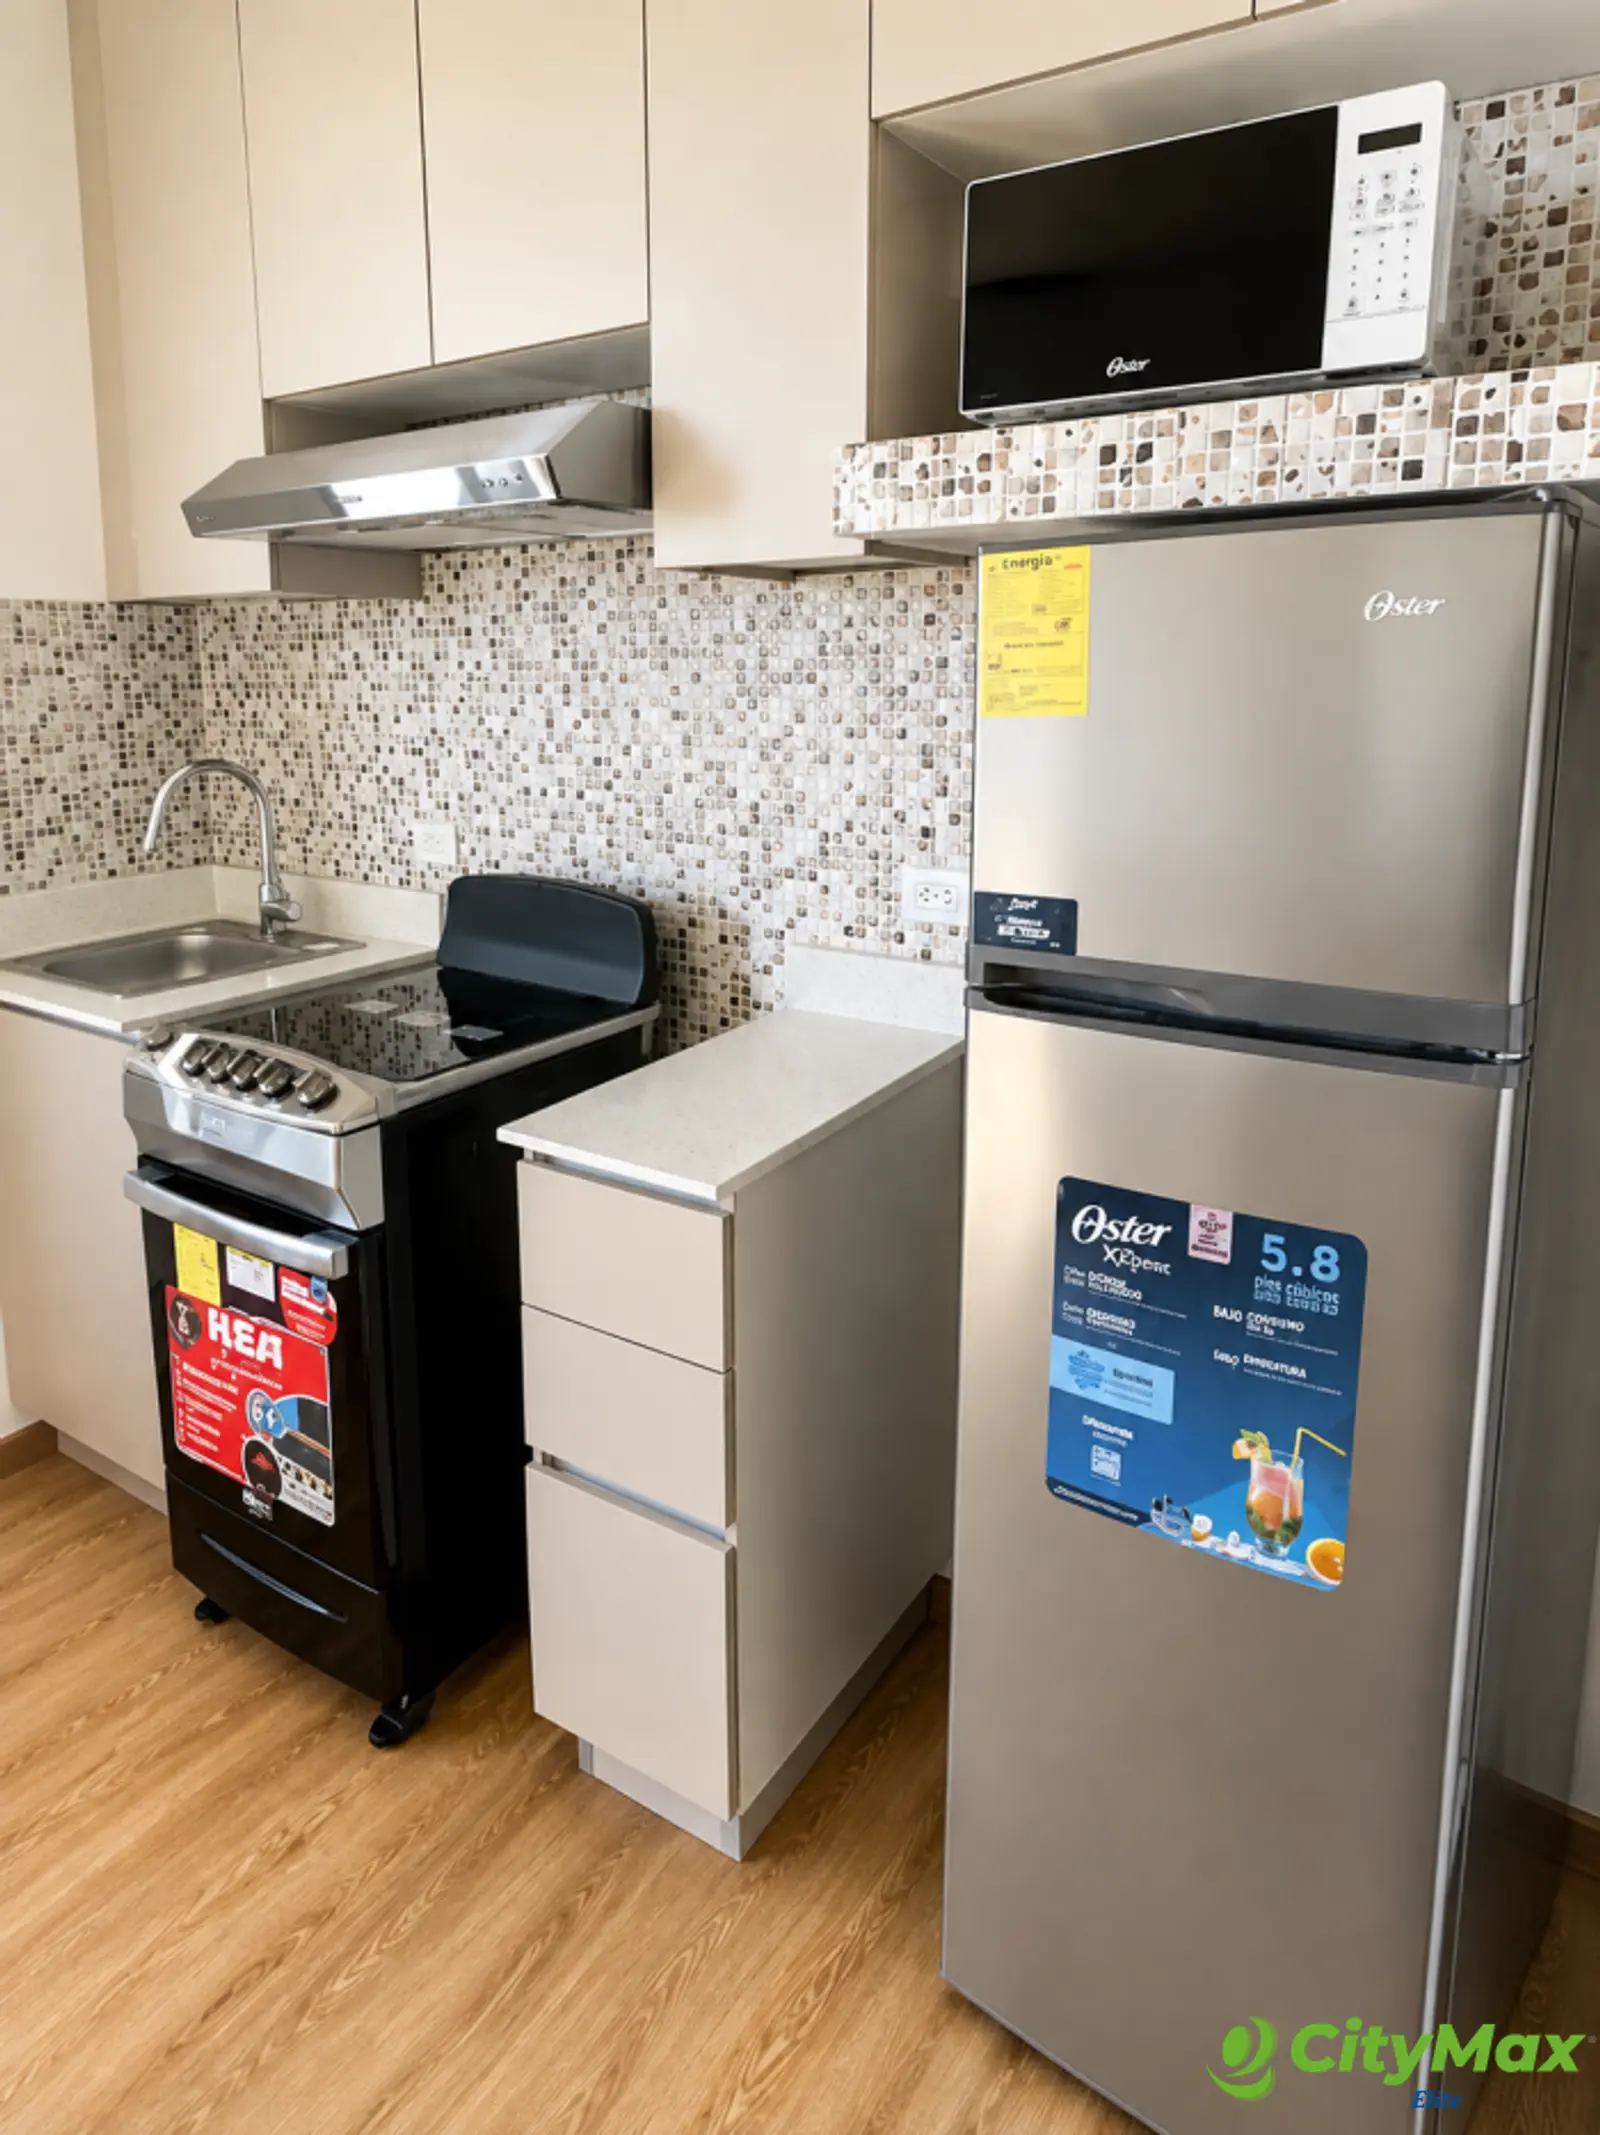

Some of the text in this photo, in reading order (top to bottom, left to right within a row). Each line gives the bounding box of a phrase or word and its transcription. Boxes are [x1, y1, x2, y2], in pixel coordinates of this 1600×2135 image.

[1364, 589, 1446, 621] Oster
[1072, 1204, 1172, 1247] Oster
[1260, 1232, 1341, 1283] 5.8
[1213, 1304, 1243, 1322] BAJO
